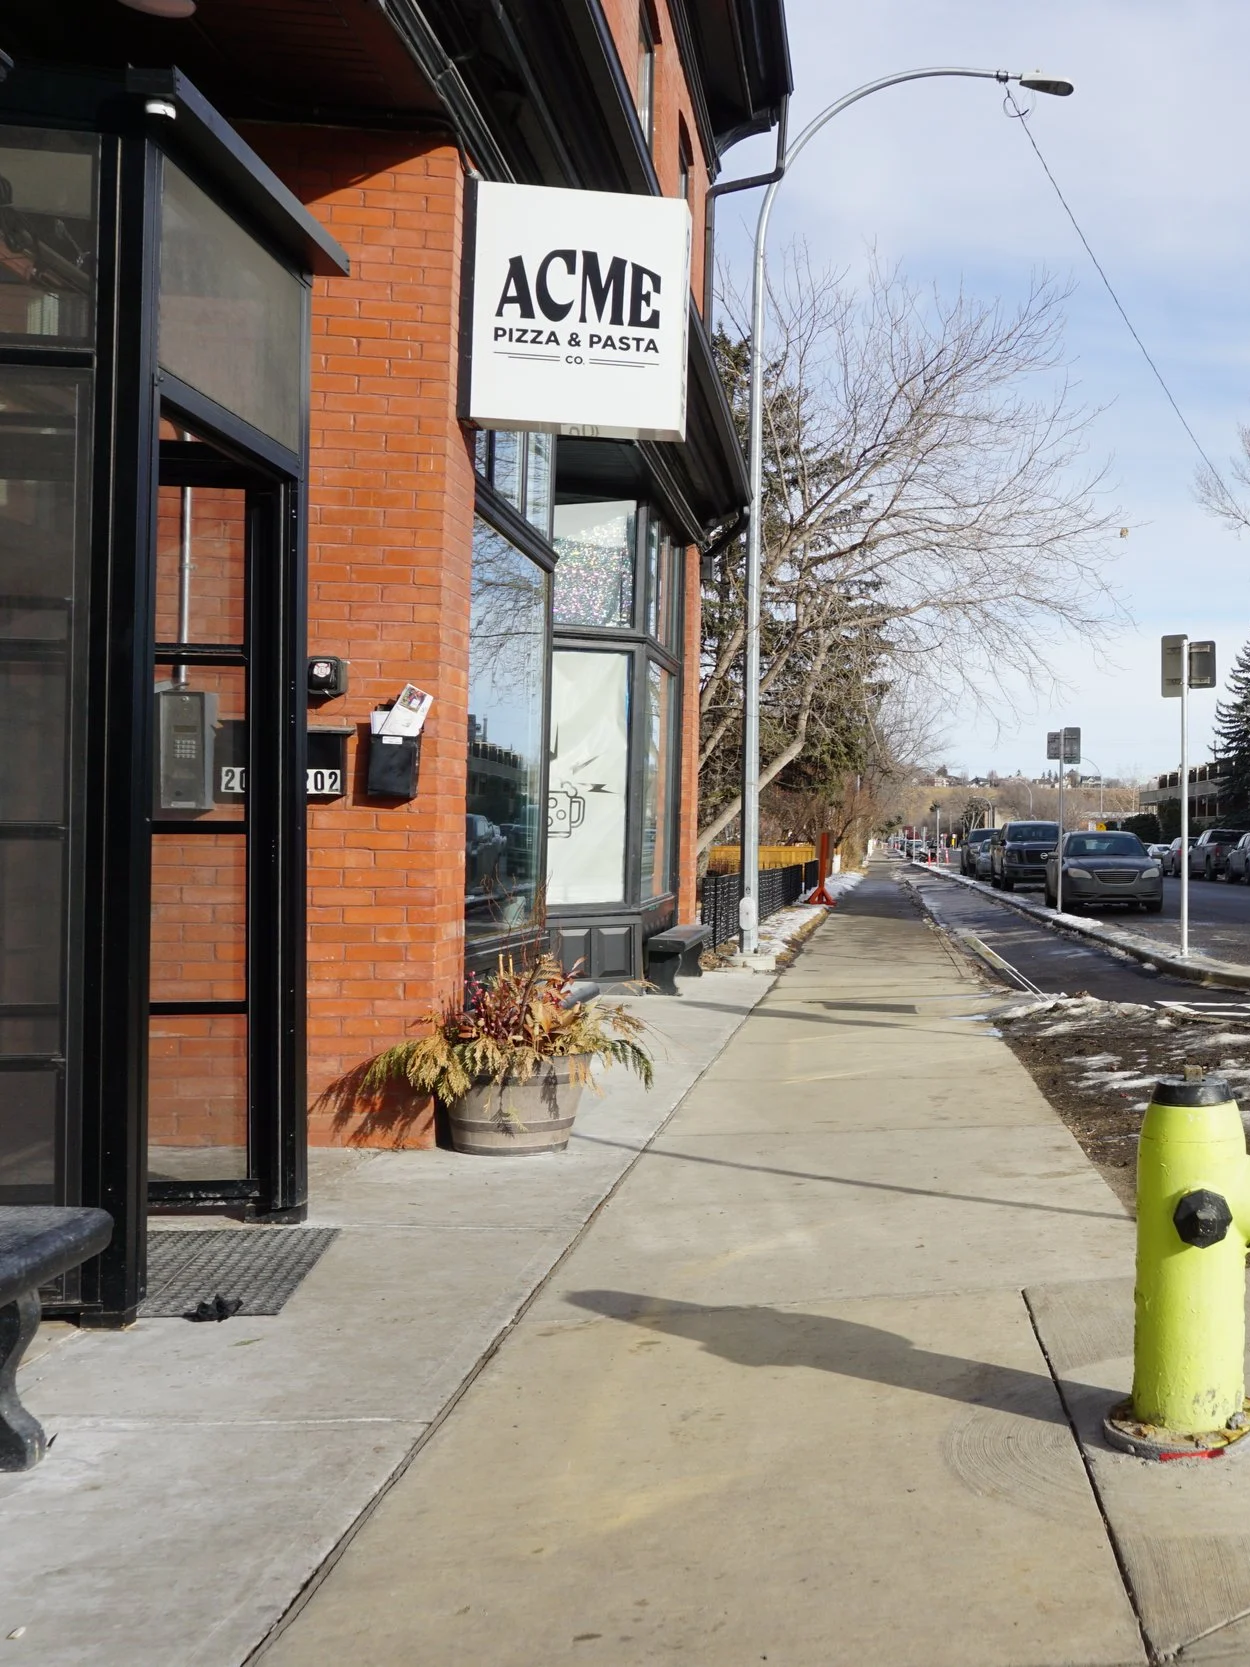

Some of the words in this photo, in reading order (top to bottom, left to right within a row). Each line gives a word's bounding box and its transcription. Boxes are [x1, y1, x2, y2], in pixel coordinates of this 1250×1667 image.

[495, 249, 661, 329] ACME
[494, 327, 560, 346] PIZZA
[567, 332, 581, 347] &
[589, 334, 659, 353] PASTA
[565, 355, 585, 365] CO.
[307, 770, 340, 792] 02
